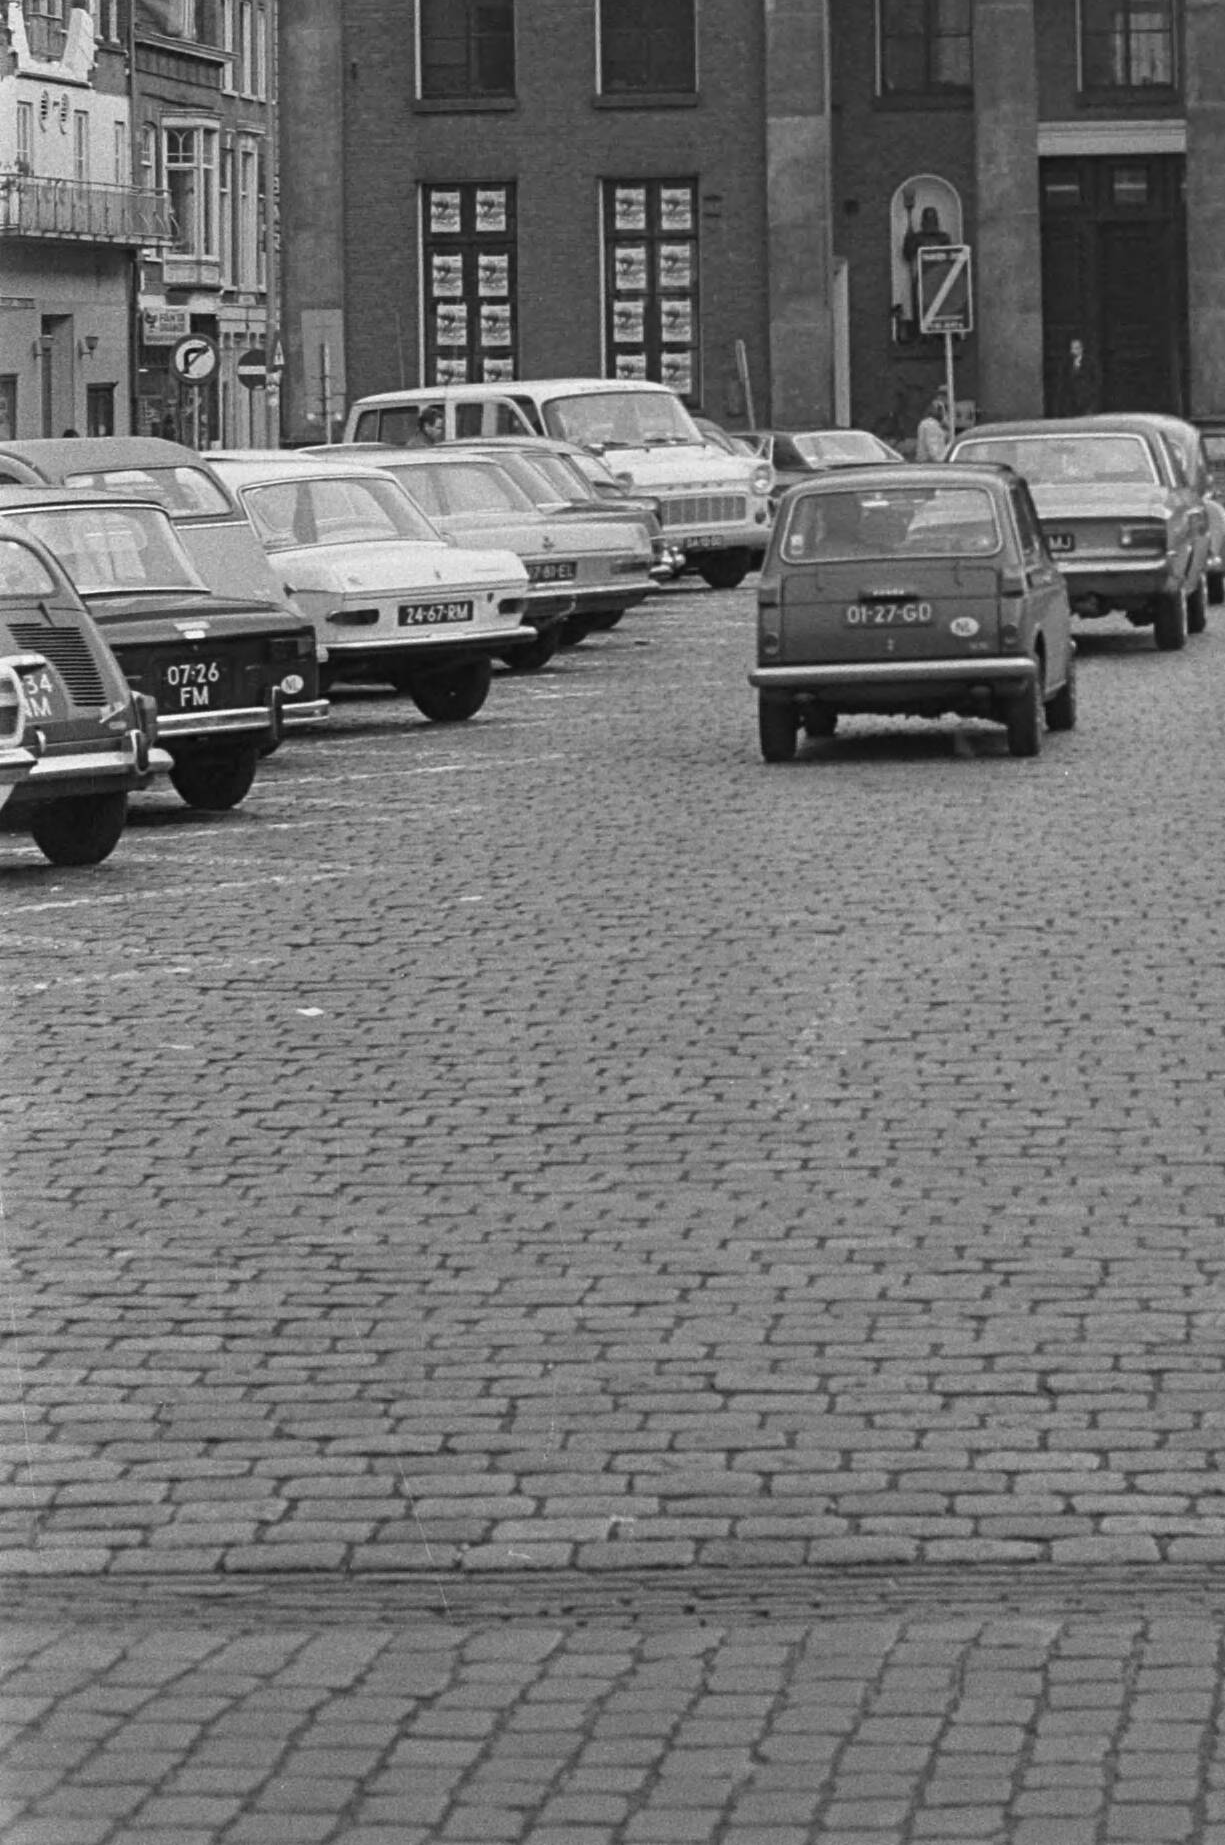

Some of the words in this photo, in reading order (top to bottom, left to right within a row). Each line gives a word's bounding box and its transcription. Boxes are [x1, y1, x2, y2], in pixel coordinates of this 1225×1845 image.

[406, 605, 469, 624] 24-67-RM
[846, 603, 932, 623] 01-27-GD
[168, 662, 220, 685] 07-26
[180, 685, 209, 707] FM
